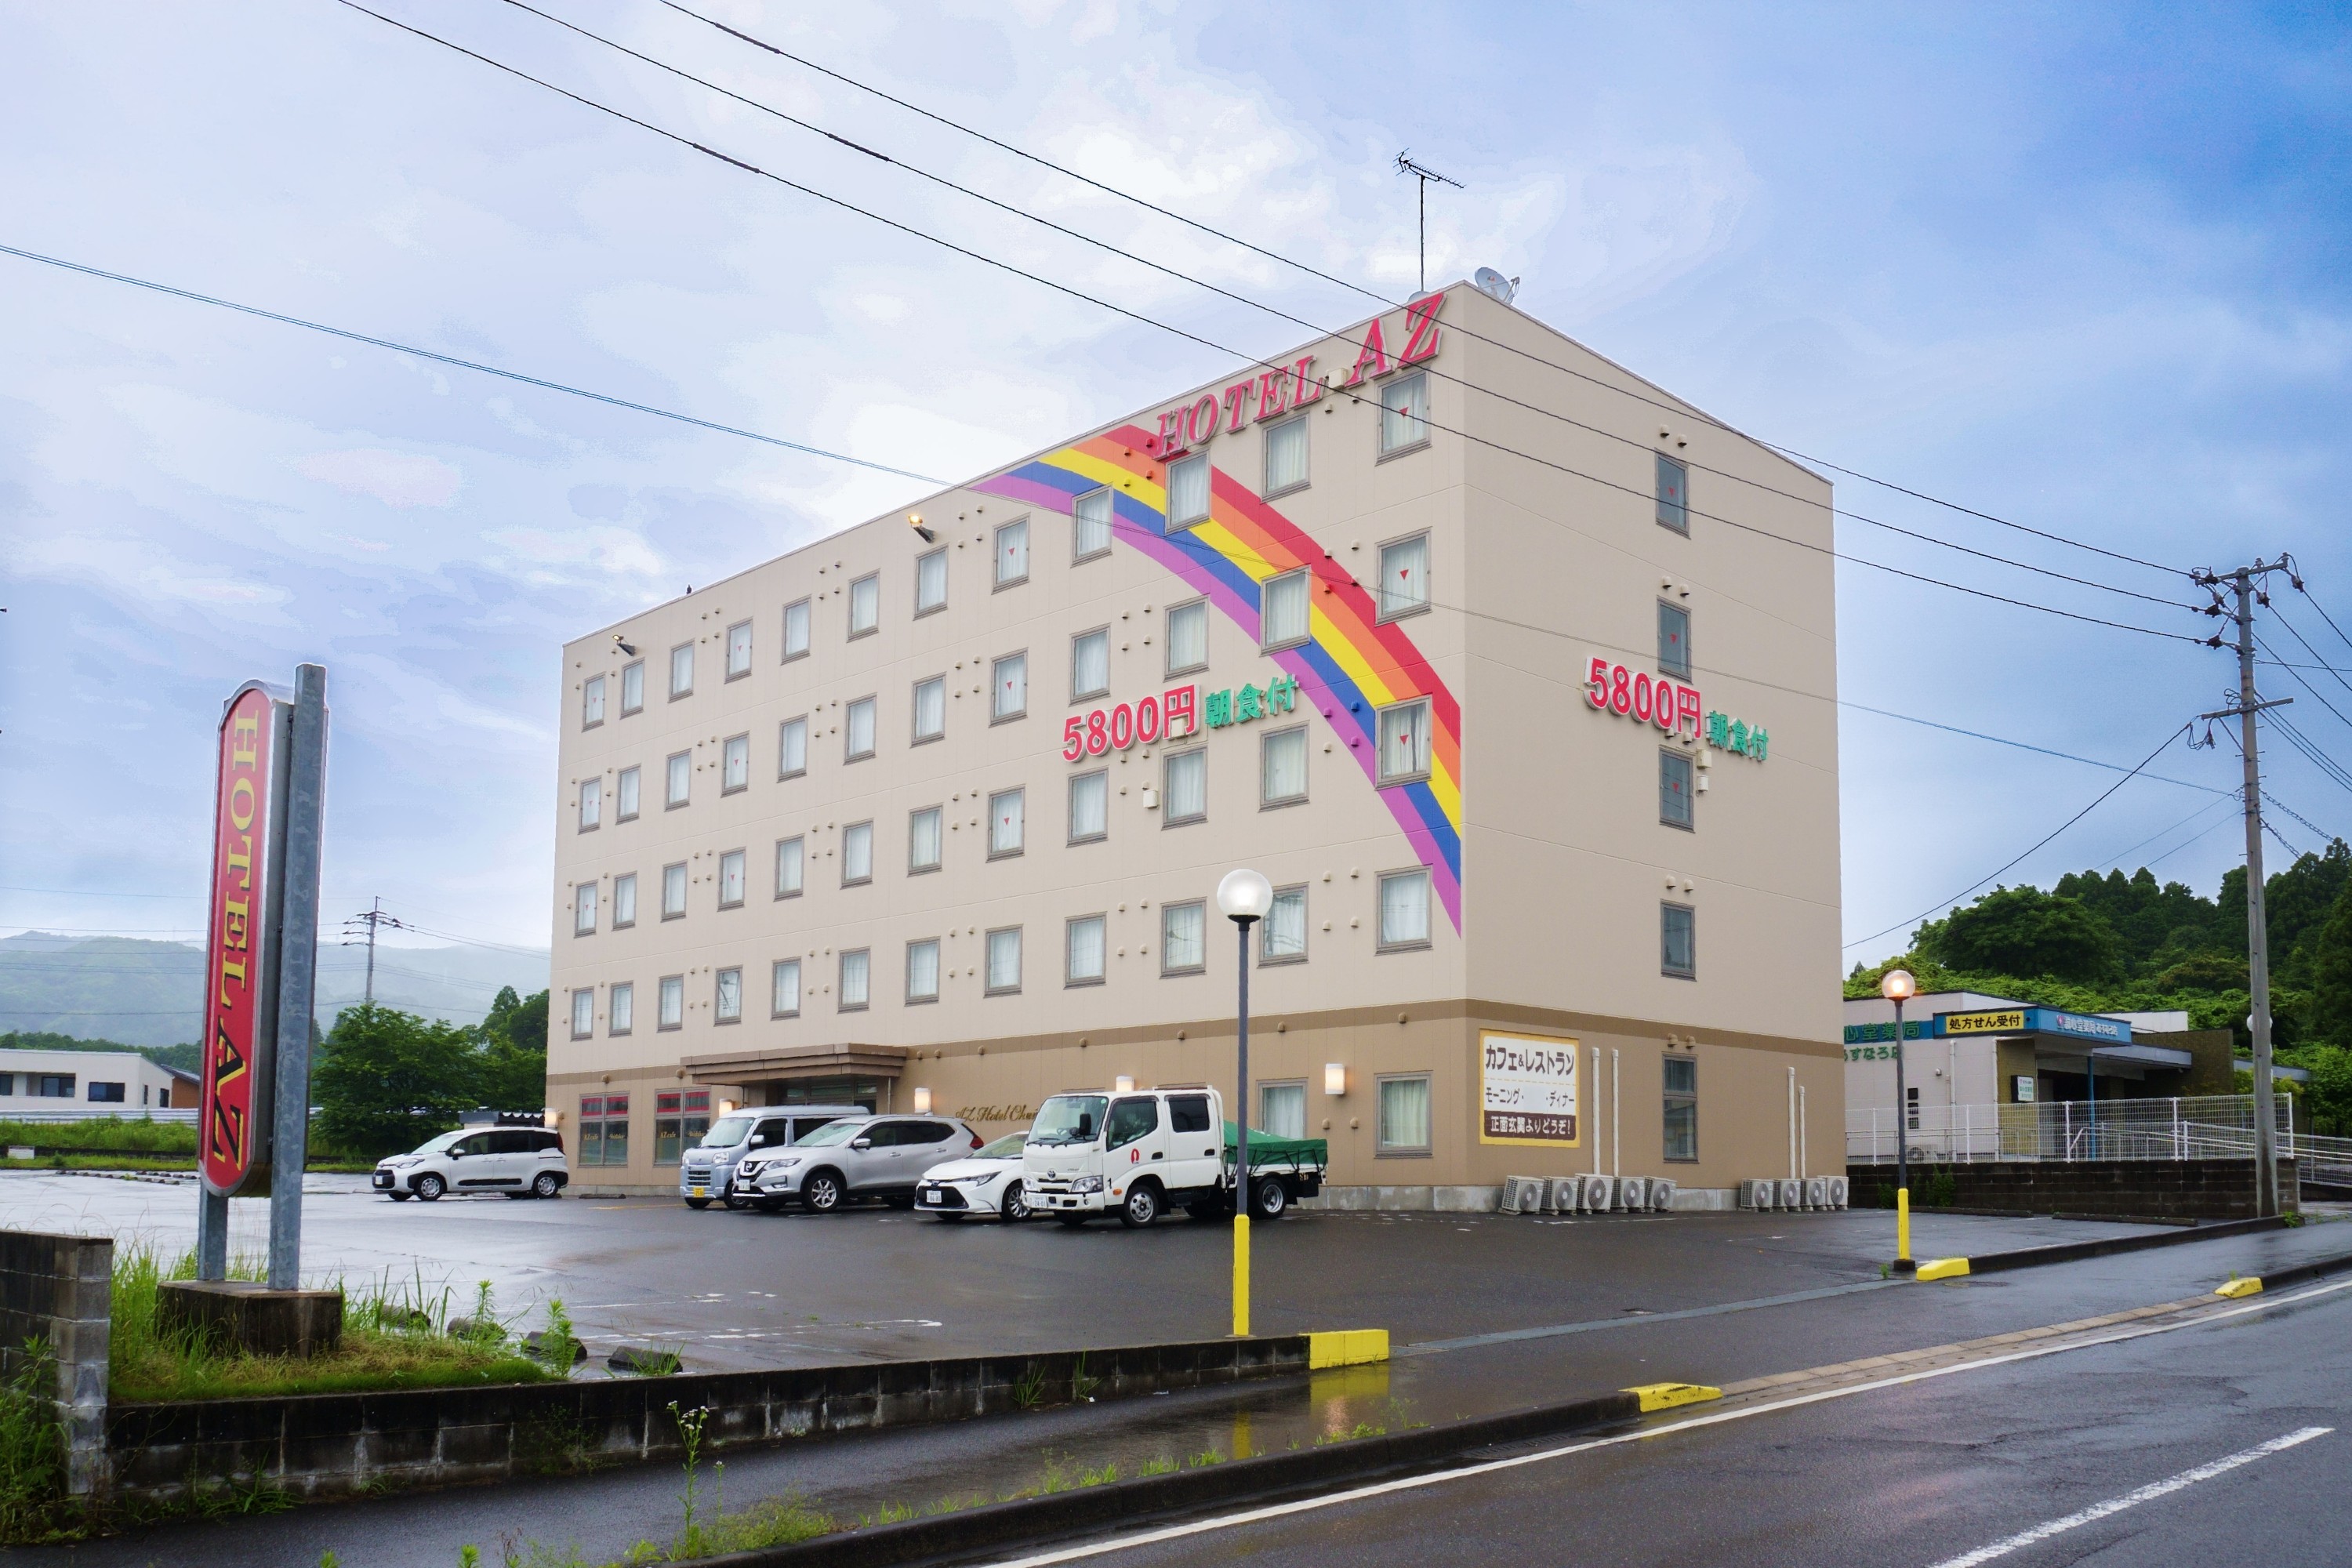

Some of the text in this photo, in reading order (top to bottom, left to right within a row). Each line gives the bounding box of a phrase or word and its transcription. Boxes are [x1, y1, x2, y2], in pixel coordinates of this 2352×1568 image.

[1152, 292, 1446, 461] HOTEL AZ
[1062, 673, 1299, 762] 5800円 朝食付
[1584, 656, 1769, 761] 5800円 朝食付
[212, 709, 260, 1171] HOTEL AZ
[1486, 1044, 1574, 1076] カフェ&レストラン
[1949, 1014, 2020, 1030] 処方せん受付
[976, 1105, 1011, 1123] Hotel
[1009, 1104, 1039, 1122] Chai
